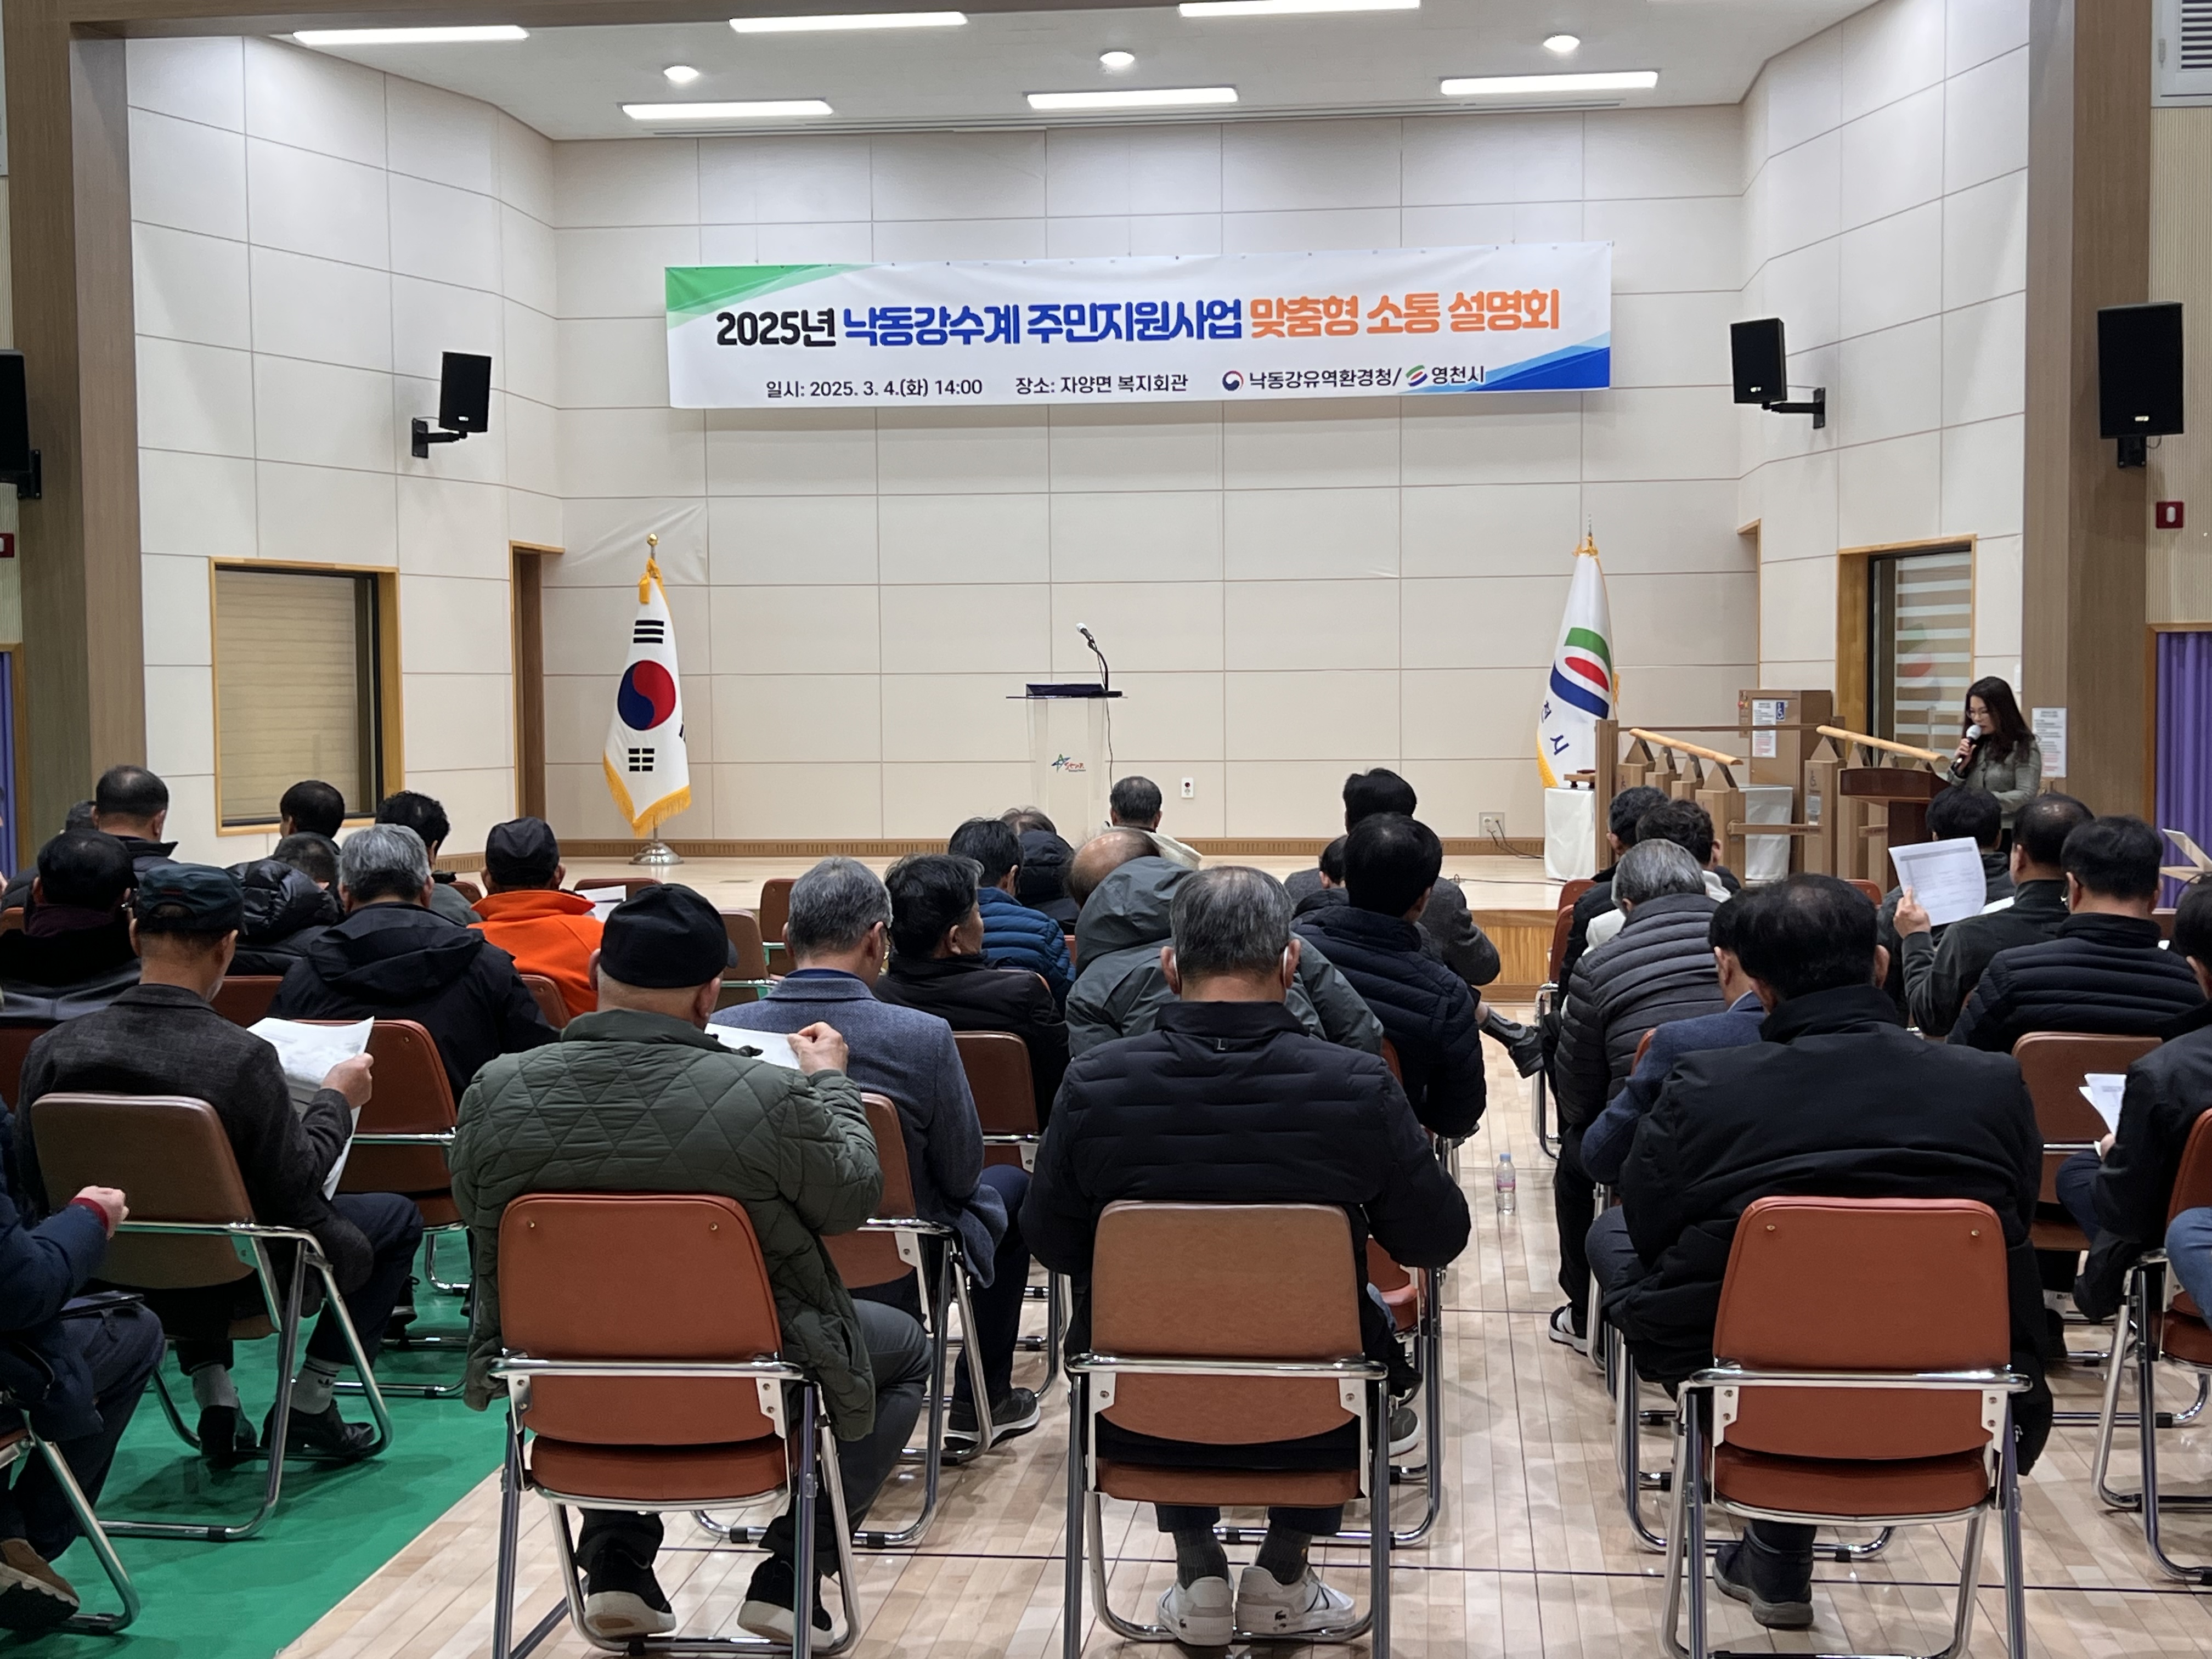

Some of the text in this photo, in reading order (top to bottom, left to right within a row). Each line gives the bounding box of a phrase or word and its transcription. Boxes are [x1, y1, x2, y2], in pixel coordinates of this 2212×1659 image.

[716, 289, 1559, 347] 2025년 낙동강수계 주민지원사업 맞춤형 소통 설명회
[1015, 374, 1189, 395] 장소: 자양면 복지회관
[1431, 365, 1484, 385] 영천시
[766, 378, 983, 399] 일시: 2025. 3. 4.(화) 14:00
